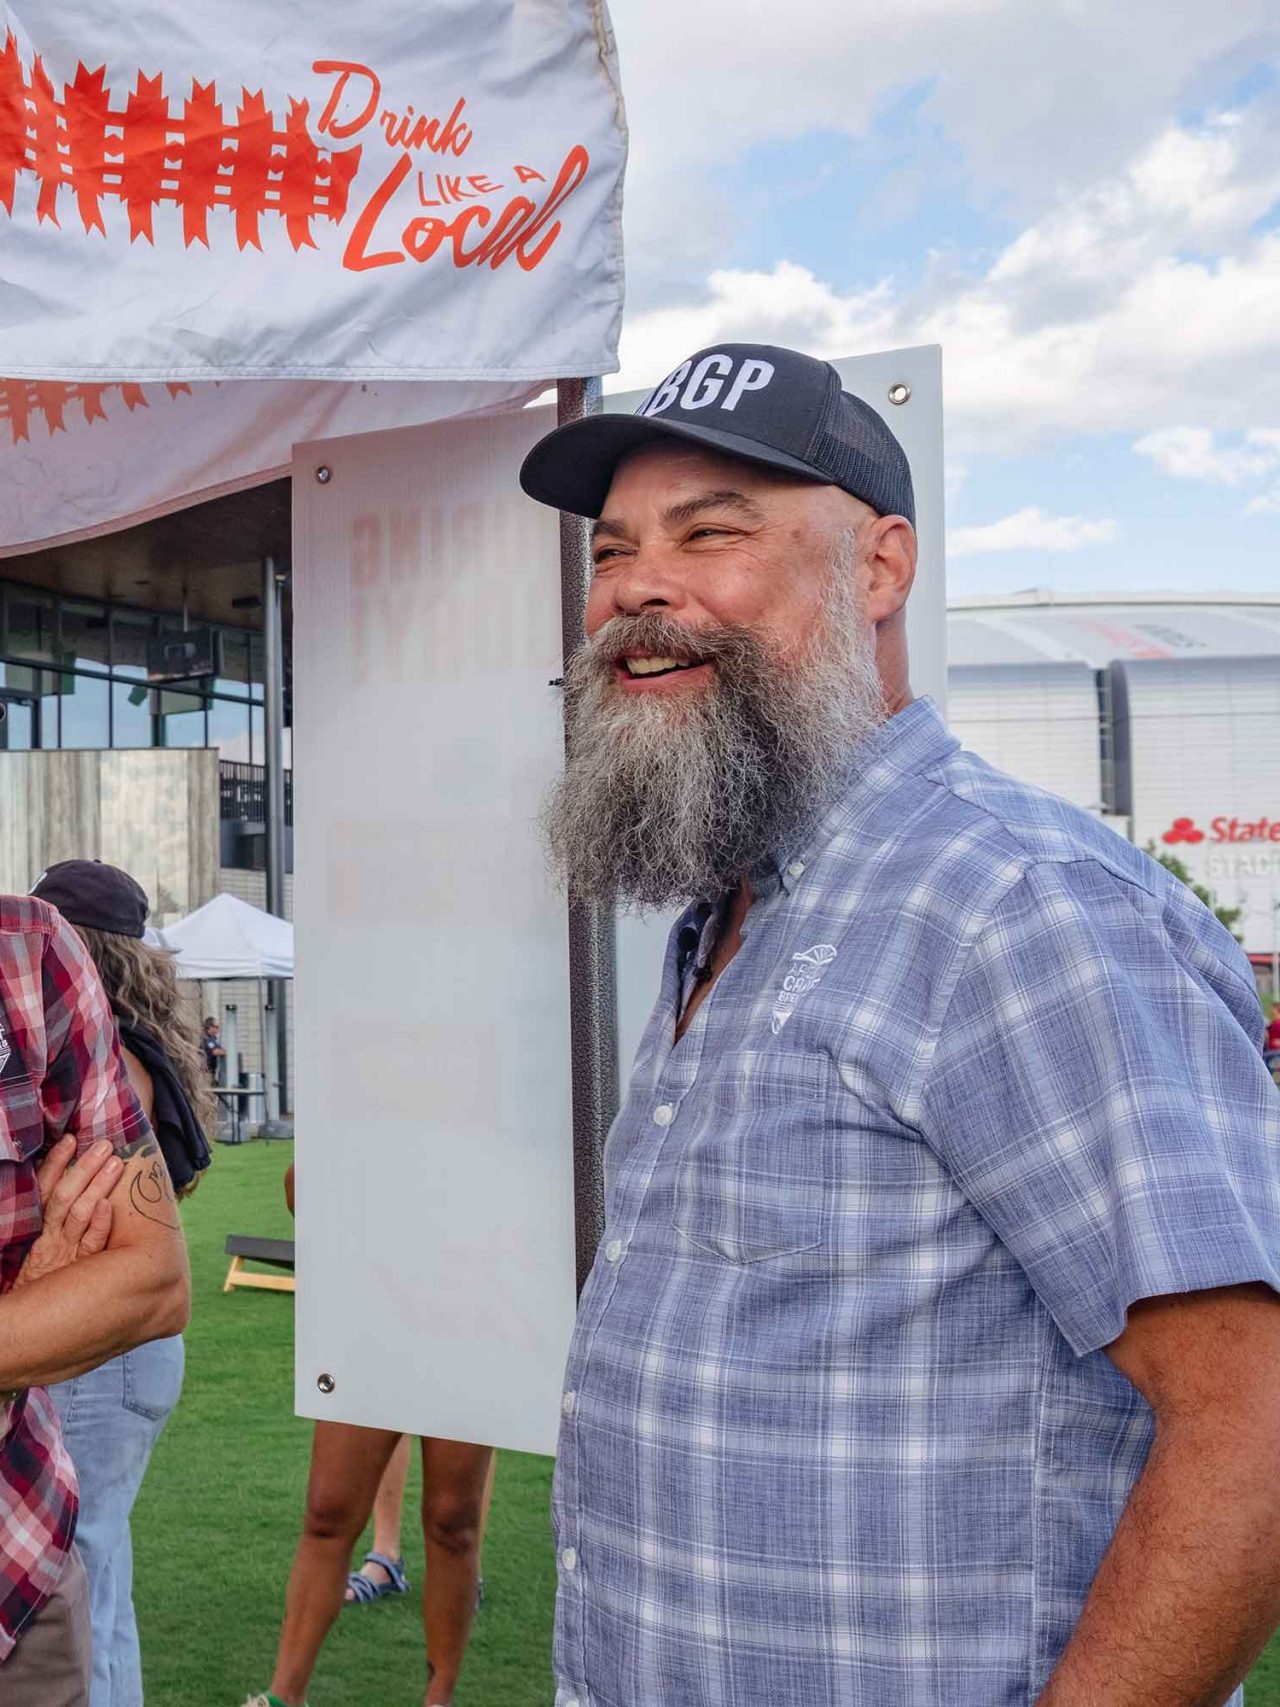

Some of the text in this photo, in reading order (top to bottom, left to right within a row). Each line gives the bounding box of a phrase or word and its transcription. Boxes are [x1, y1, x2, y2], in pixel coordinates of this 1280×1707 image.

[312, 60, 473, 157] Drink
[342, 144, 589, 272] Local
[419, 165, 546, 207] LIKE A
[634, 353, 775, 417] BGP
[1211, 816, 1280, 842] State
